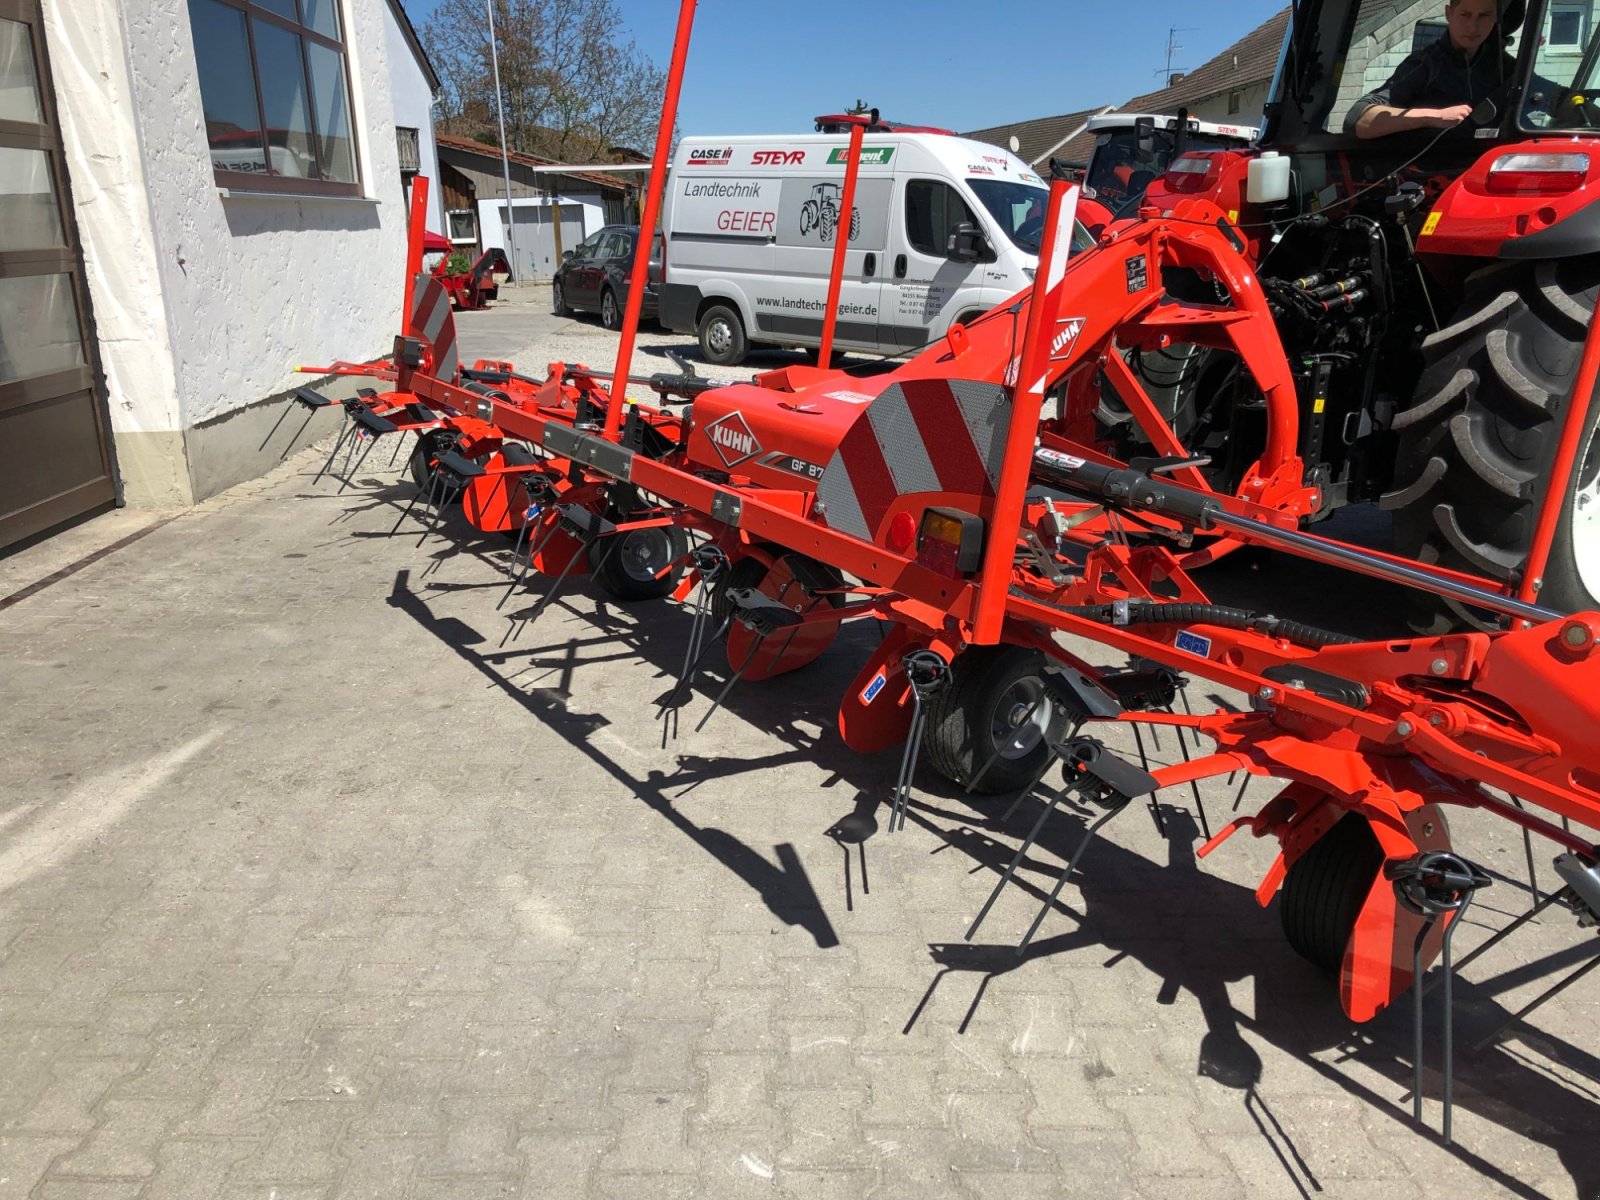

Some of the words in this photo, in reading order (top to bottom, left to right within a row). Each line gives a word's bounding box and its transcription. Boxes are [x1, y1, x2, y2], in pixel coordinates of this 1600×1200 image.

[1217, 126, 1238, 134] STEYR
[690, 149, 722, 159] CASE
[750, 151, 806, 165] STEYR
[684, 181, 761, 198] Landtechnik
[717, 210, 776, 232] GEIER
[713, 425, 753, 455] KUHN
[791, 459, 807, 472] GF
